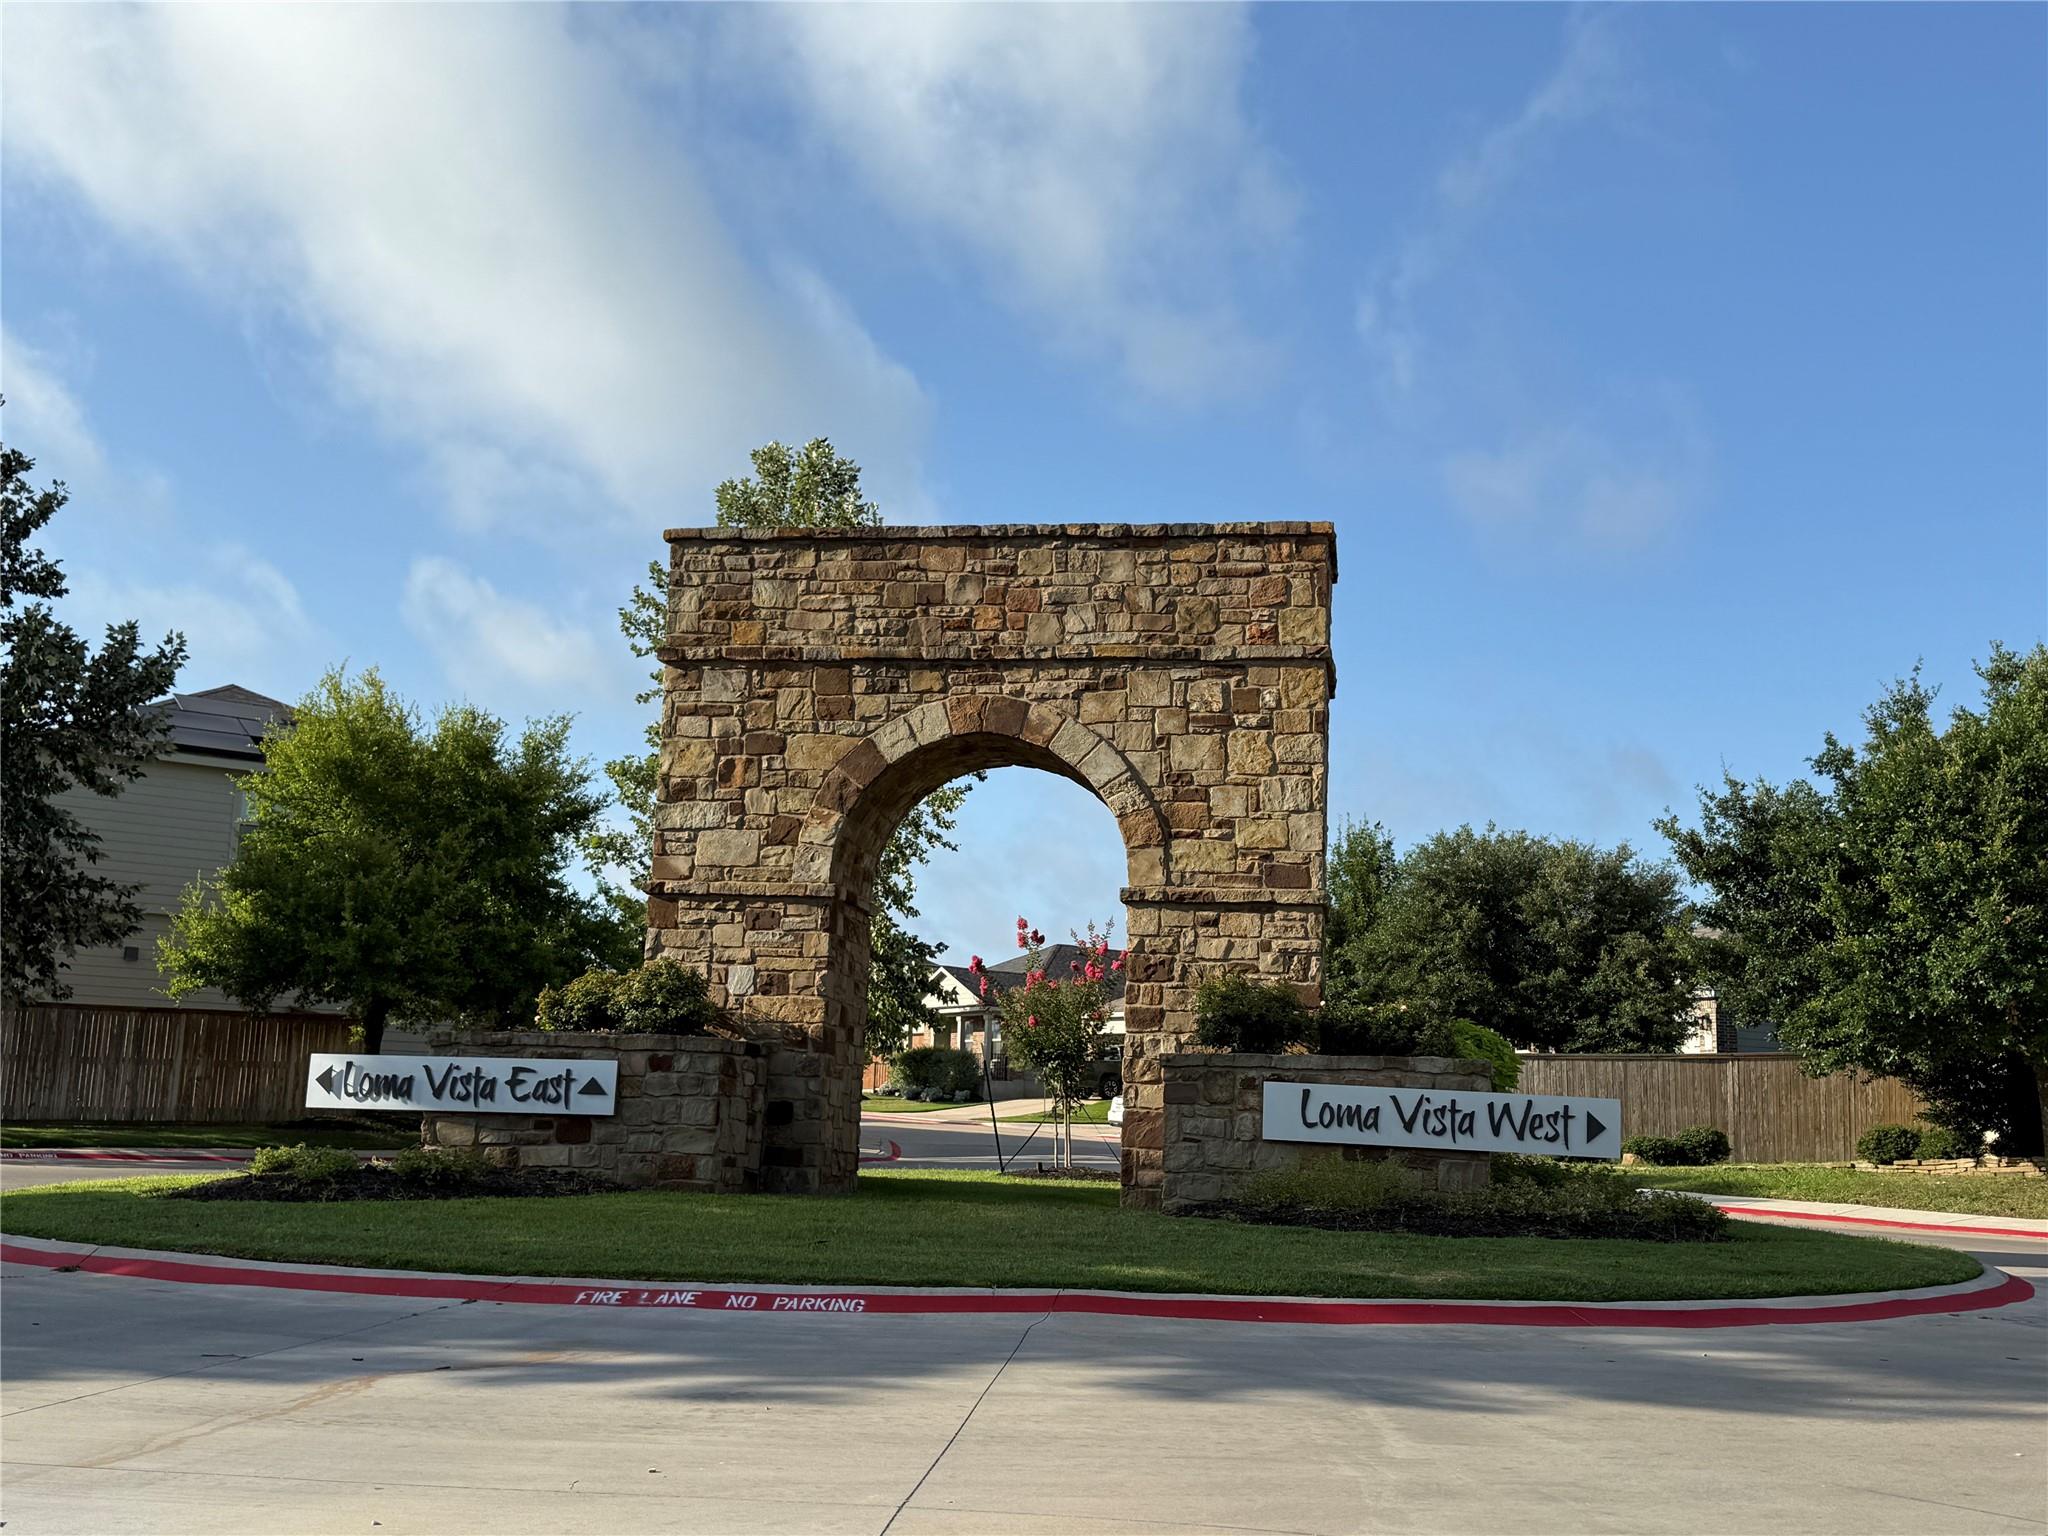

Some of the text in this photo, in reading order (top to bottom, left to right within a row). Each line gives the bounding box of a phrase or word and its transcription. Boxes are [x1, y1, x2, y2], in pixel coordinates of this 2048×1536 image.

[343, 1061, 577, 1110] Loma Vista East
[1301, 1088, 1576, 1150] Loma Vista West
[574, 1290, 866, 1313] FIRE LANE NO PARKING
